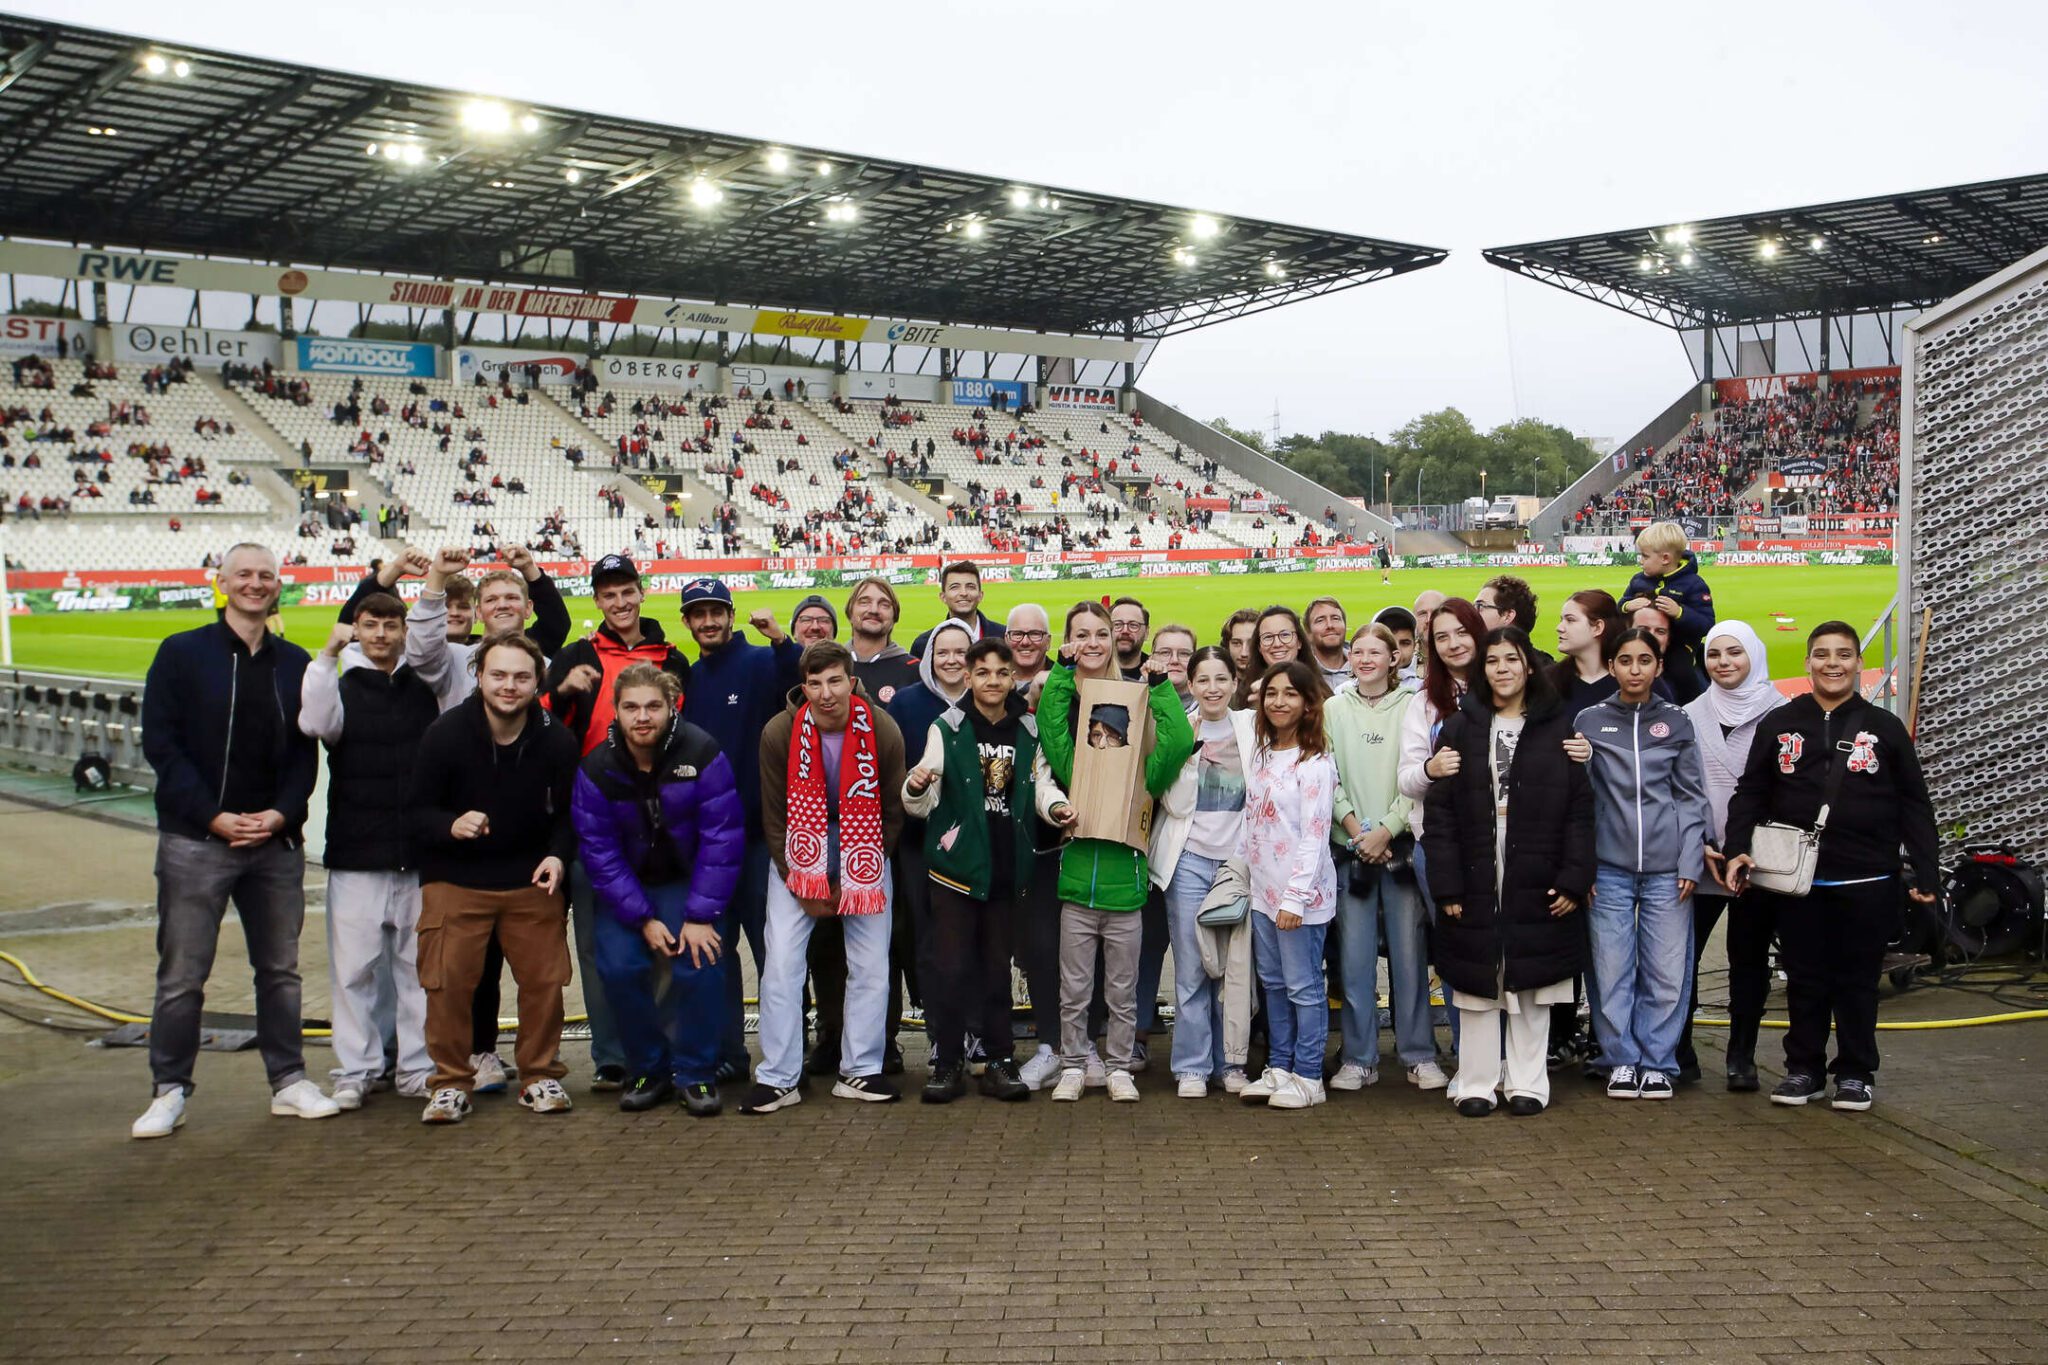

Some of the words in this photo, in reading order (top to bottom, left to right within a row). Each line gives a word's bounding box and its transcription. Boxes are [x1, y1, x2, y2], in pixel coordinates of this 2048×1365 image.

[78, 253, 179, 284] RWE
[390, 281, 454, 307] STADION
[461, 287, 484, 308] AN
[487, 289, 517, 311] DER
[685, 311, 729, 326] Allbau
[0, 317, 67, 341] STI
[903, 326, 945, 344] BITE
[129, 325, 249, 358] Oehler
[1809, 517, 1845, 531] RUDE
[1316, 557, 1373, 570] STADIONWURST
[1488, 554, 1567, 565] STADIONWURST
[1717, 551, 1807, 564] STADIONWURST
[1141, 560, 1209, 575] STADIONWURST
[52, 589, 132, 611] Thiers
